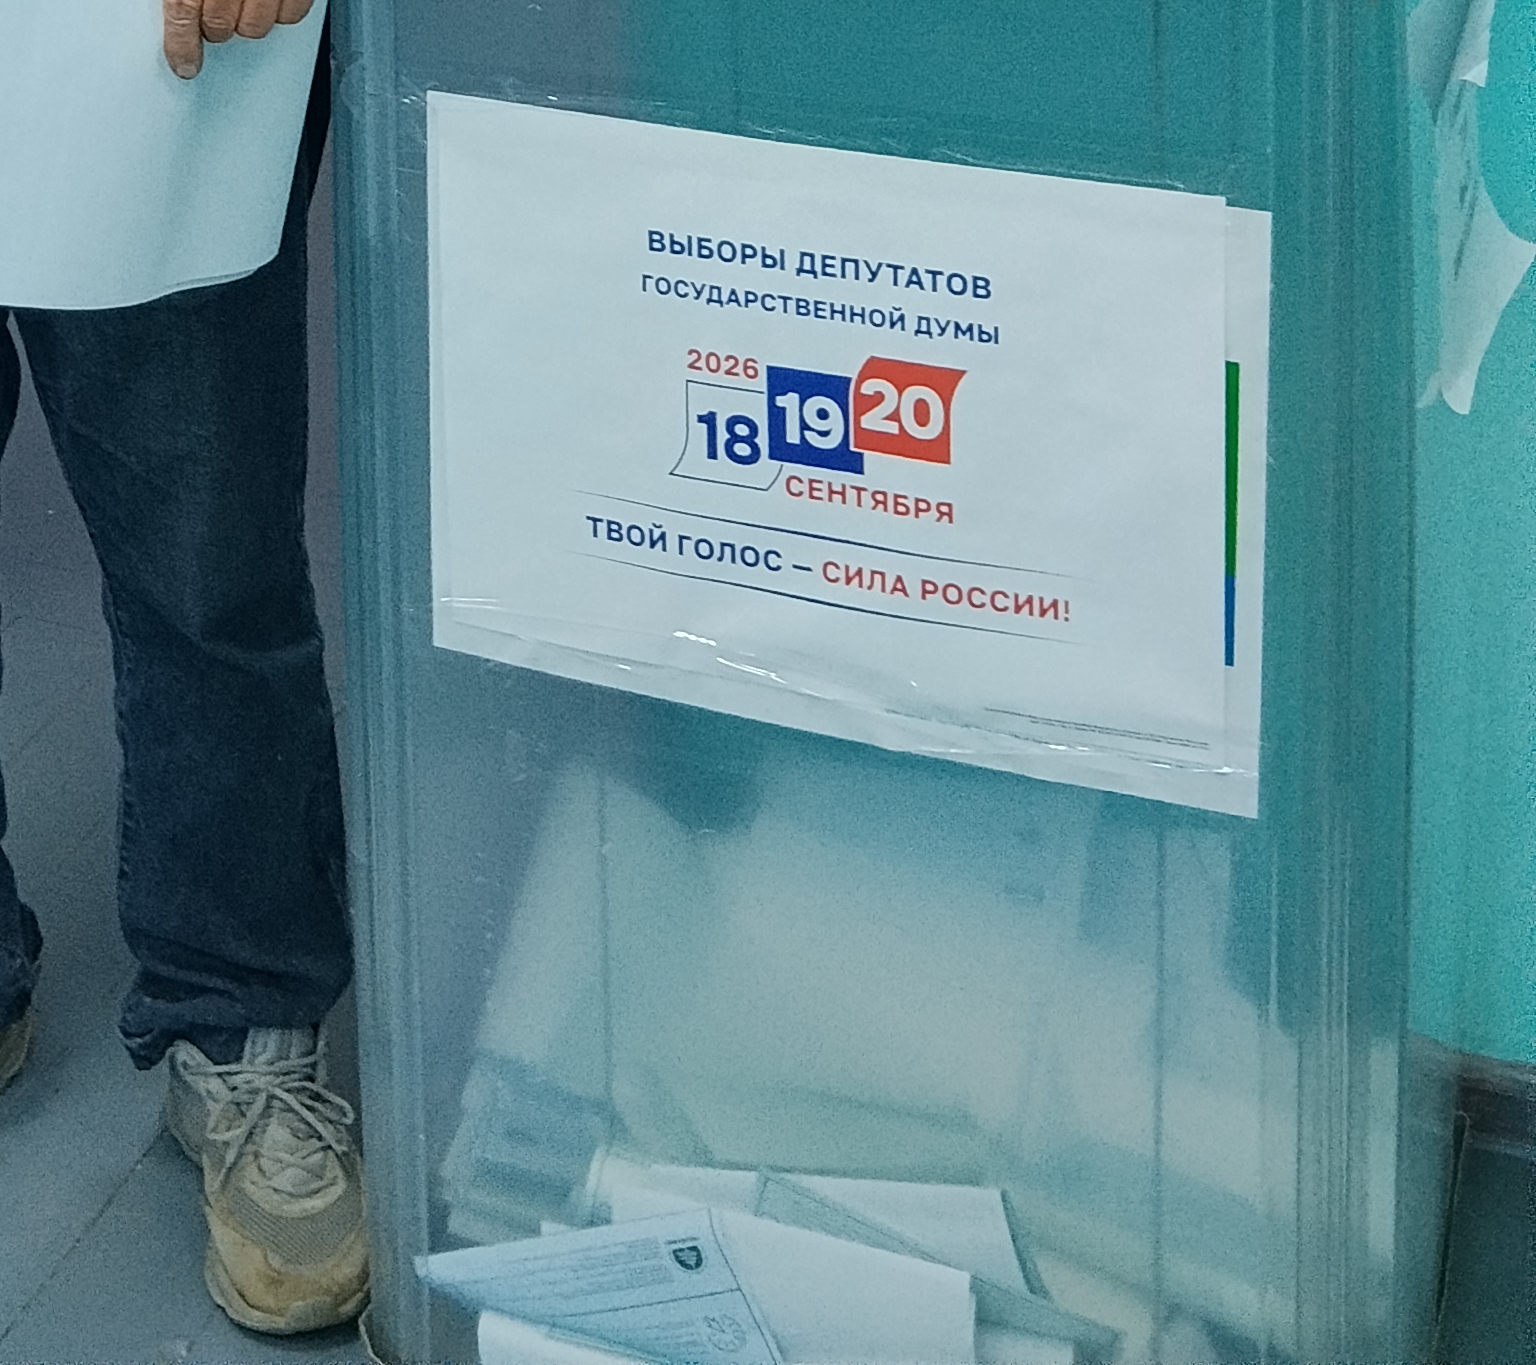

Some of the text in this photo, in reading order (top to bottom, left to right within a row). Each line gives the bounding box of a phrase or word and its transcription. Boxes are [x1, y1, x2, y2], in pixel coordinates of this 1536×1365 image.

[647, 229, 993, 301] ВЫБОРЫ ДЕПУТАТОВ
[640, 273, 1000, 345] ГОСУДАРСТВЕННОЙ ДУМЫ
[686, 348, 760, 381] 2026
[695, 378, 945, 465] 18 19 20
[784, 475, 956, 526] СЕНТЯБРЯ
[586, 514, 667, 554] ТВОЙ
[677, 533, 783, 573] ГОЛОС
[822, 558, 911, 600] СИЛА
[921, 577, 1072, 623] РОССИИ!
